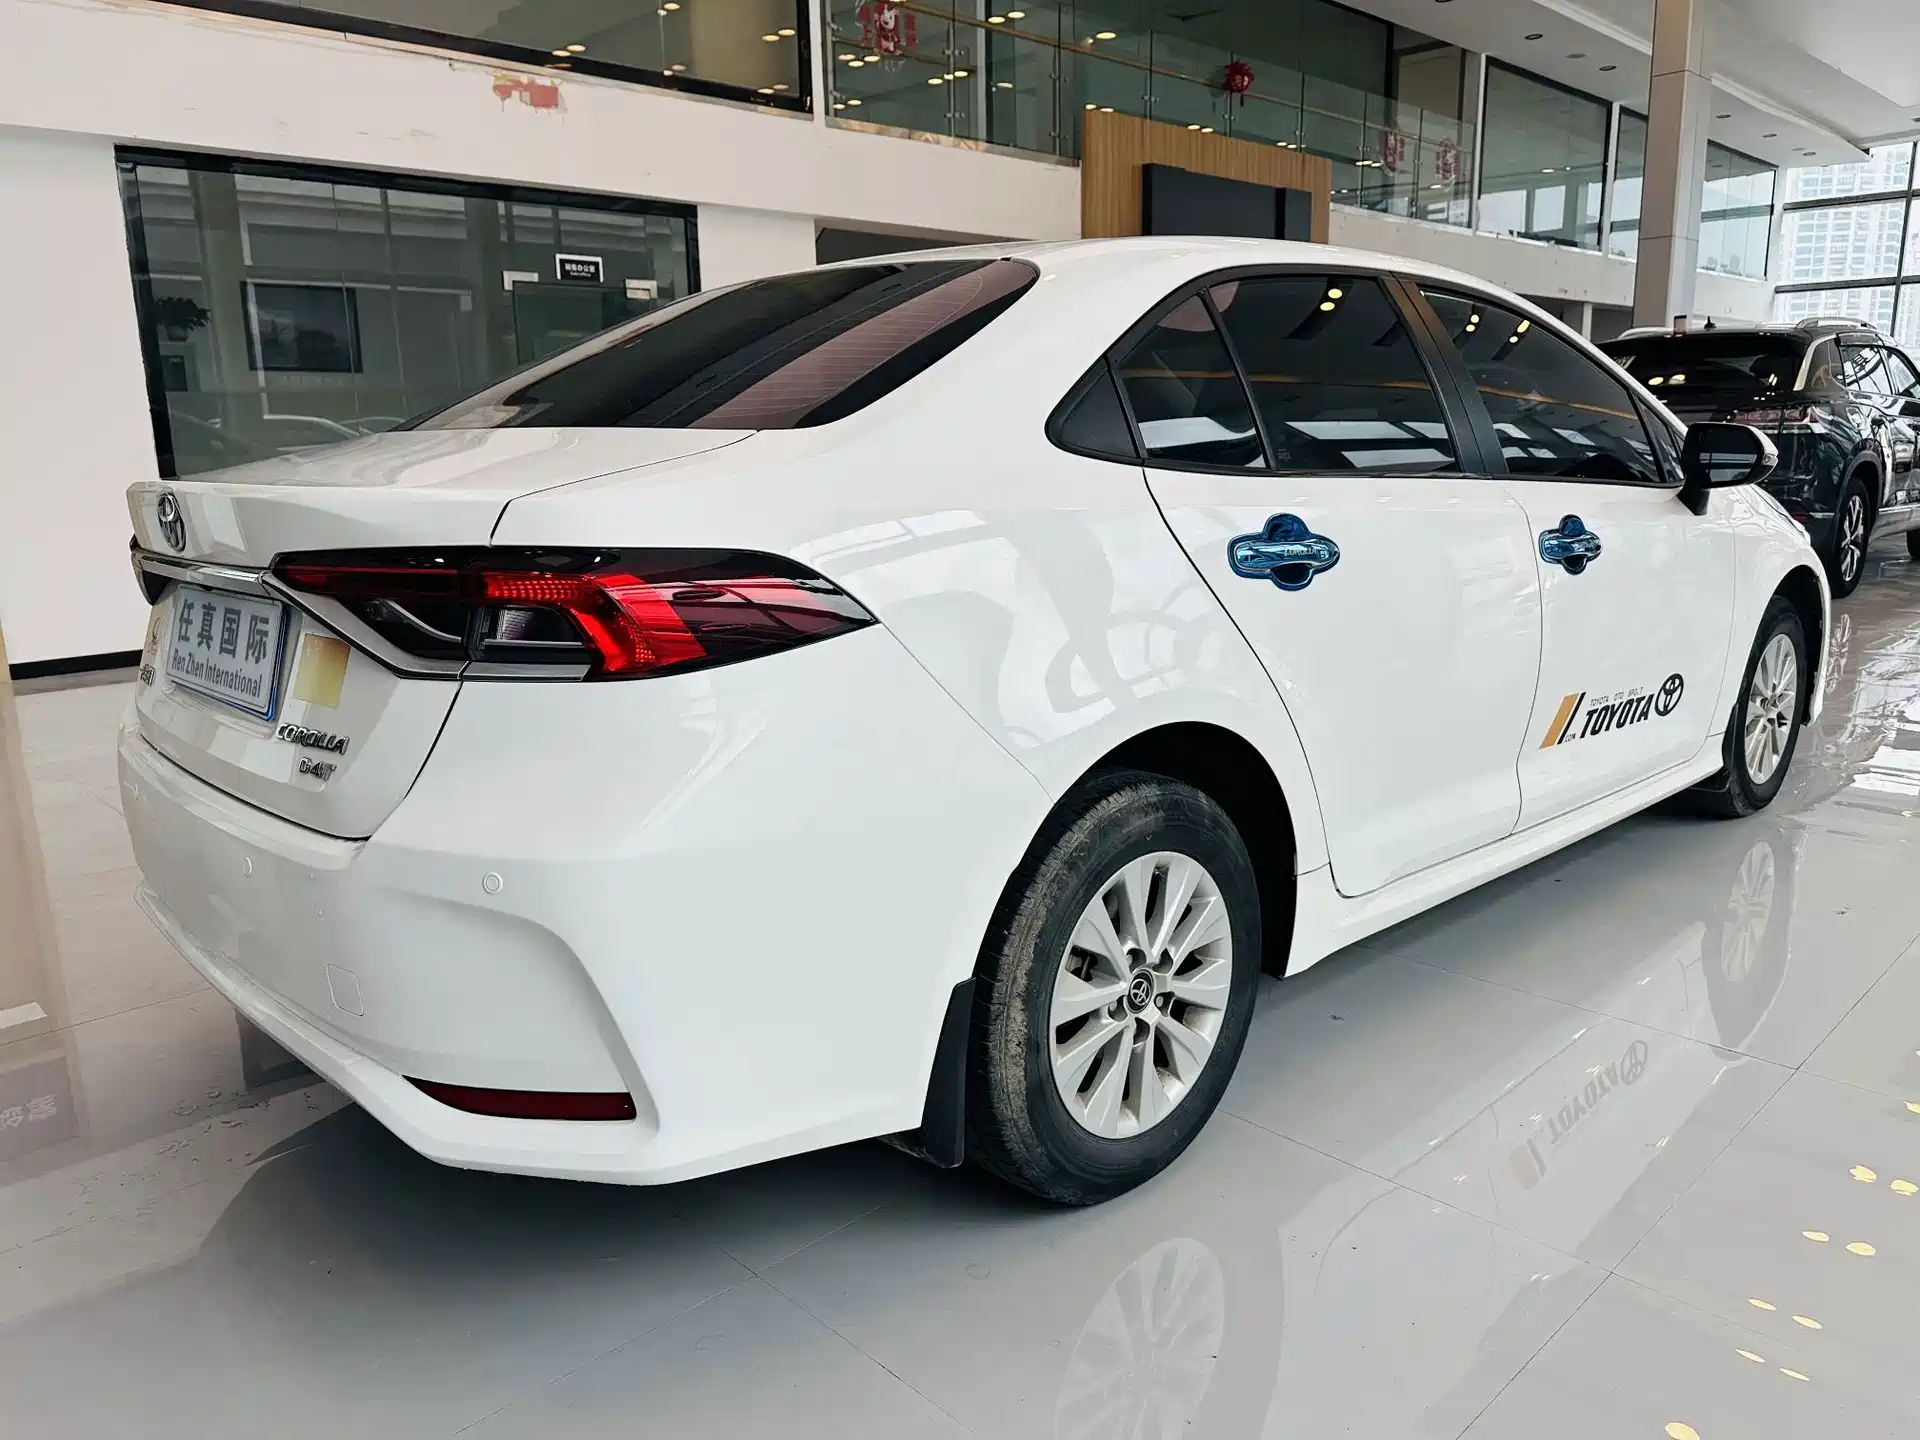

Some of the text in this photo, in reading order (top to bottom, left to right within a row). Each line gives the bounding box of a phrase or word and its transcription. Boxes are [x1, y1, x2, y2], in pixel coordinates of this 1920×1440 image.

[178, 599, 269, 665] 任真国际
[172, 648, 186, 672] Ren
[185, 652, 205, 679] Zhen
[204, 658, 263, 698] International
[276, 723, 350, 755] COROLLA
[1580, 694, 1654, 739] TOYOTA
